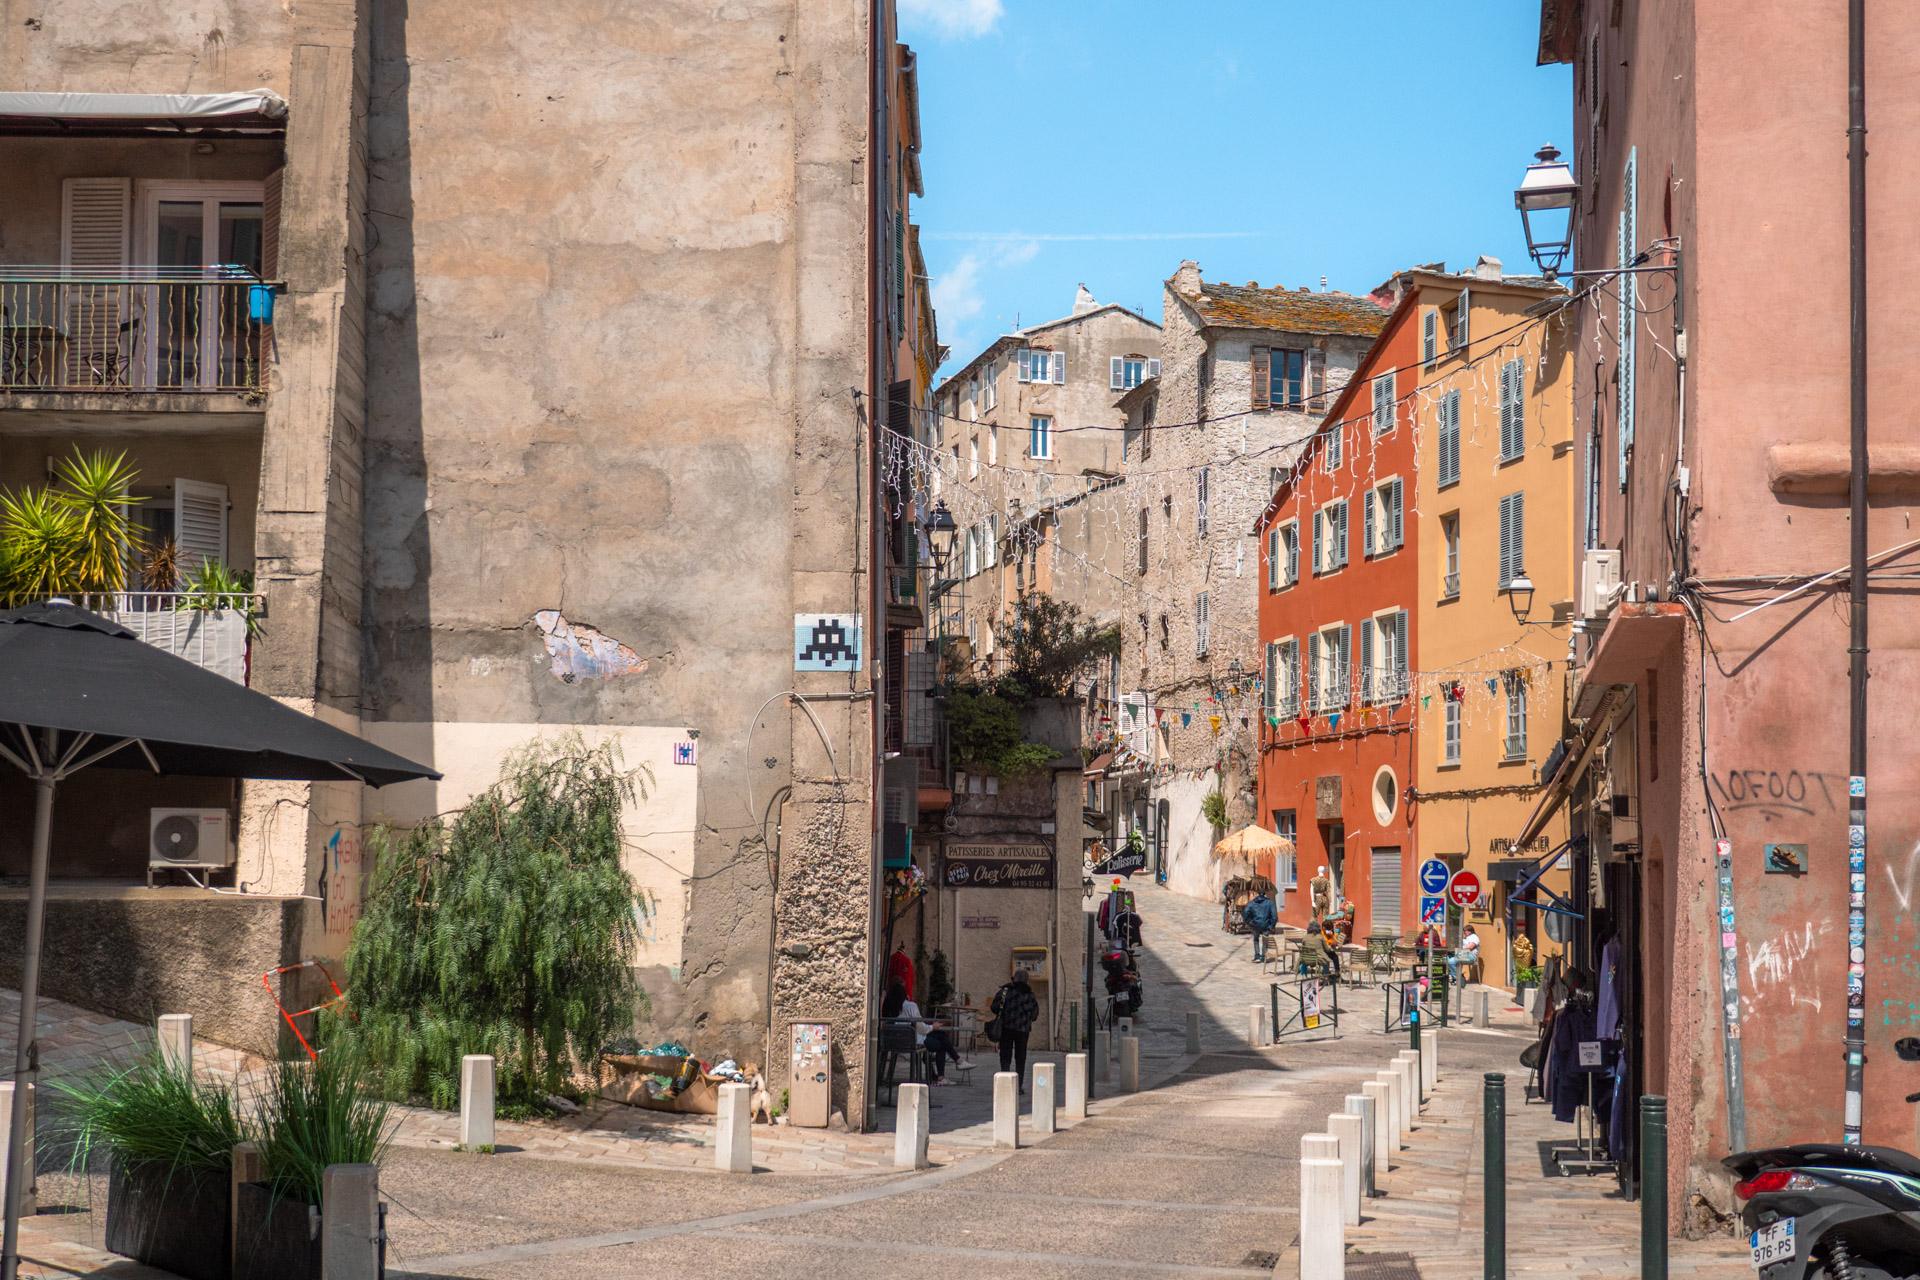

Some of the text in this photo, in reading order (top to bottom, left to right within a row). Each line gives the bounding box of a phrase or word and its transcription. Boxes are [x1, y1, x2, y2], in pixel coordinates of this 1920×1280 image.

[974, 863, 1046, 885] Chez Mireille
[1753, 1239, 1792, 1263] 976-PS
